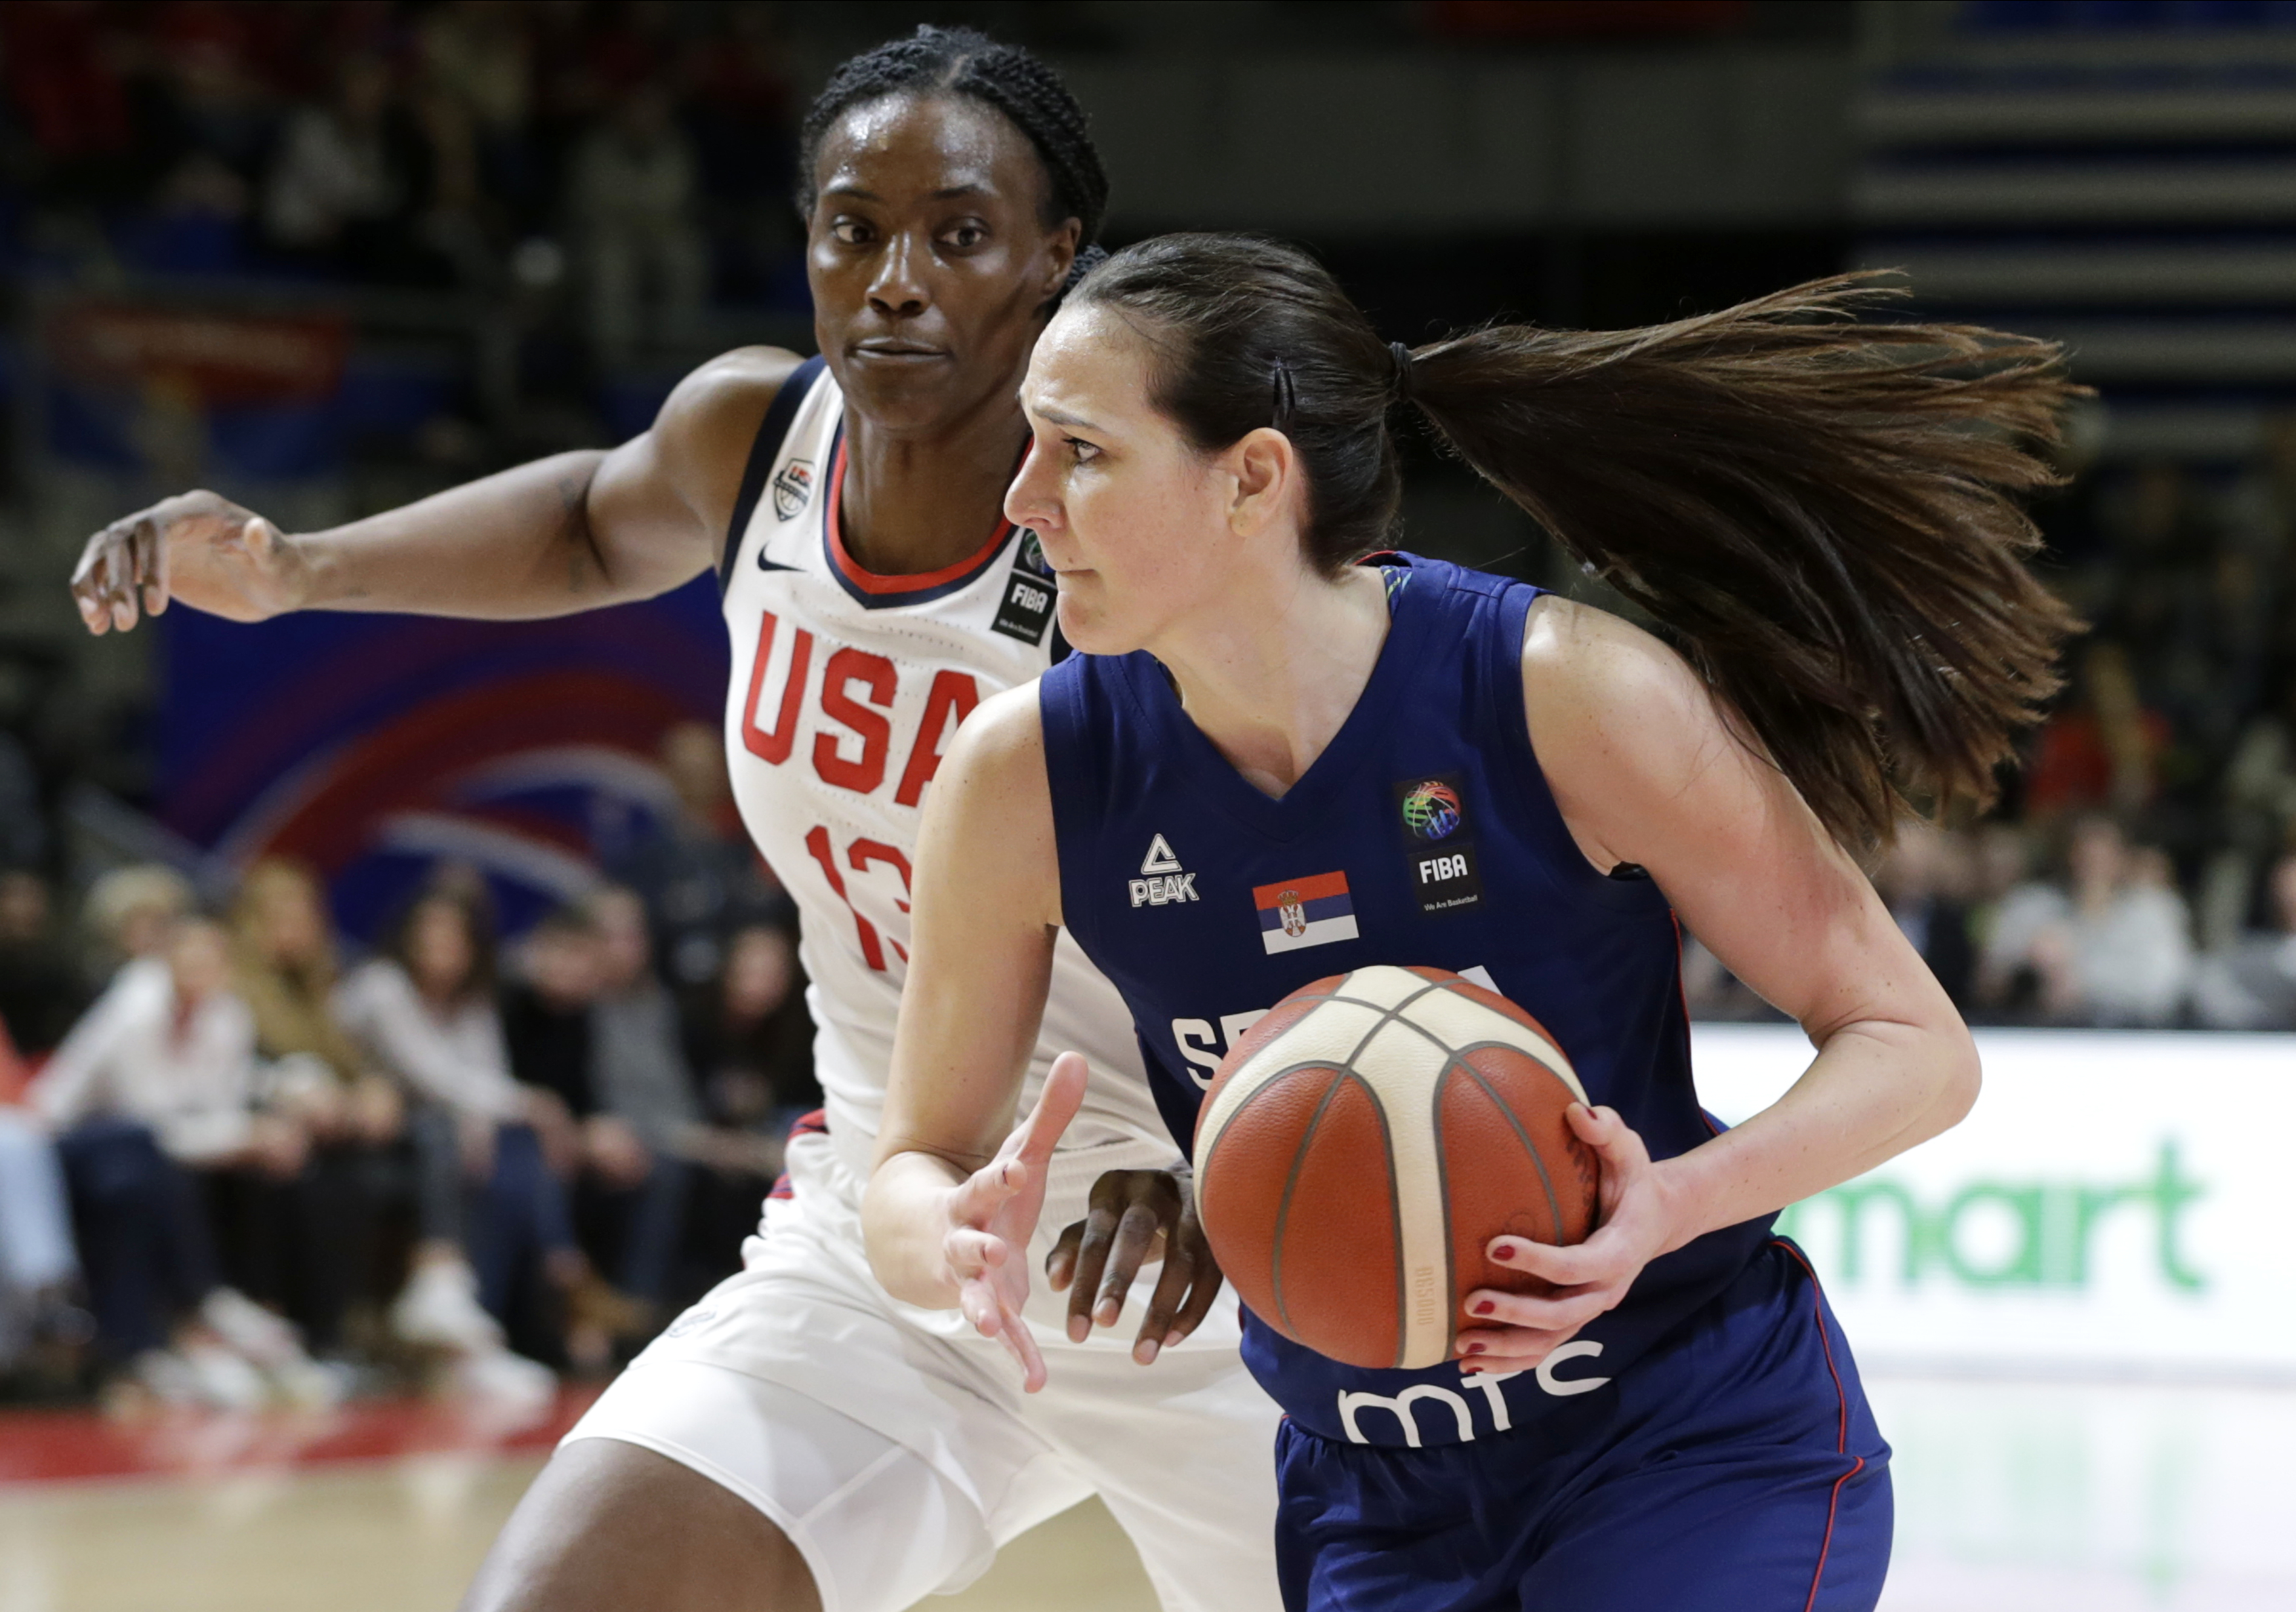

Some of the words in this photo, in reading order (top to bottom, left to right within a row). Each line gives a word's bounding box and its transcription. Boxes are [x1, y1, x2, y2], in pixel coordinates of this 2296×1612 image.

[1011, 582, 1048, 614] FIBA
[742, 610, 980, 807] USA
[1419, 854, 1468, 883] FIBA
[1129, 873, 1199, 907] PEAK
